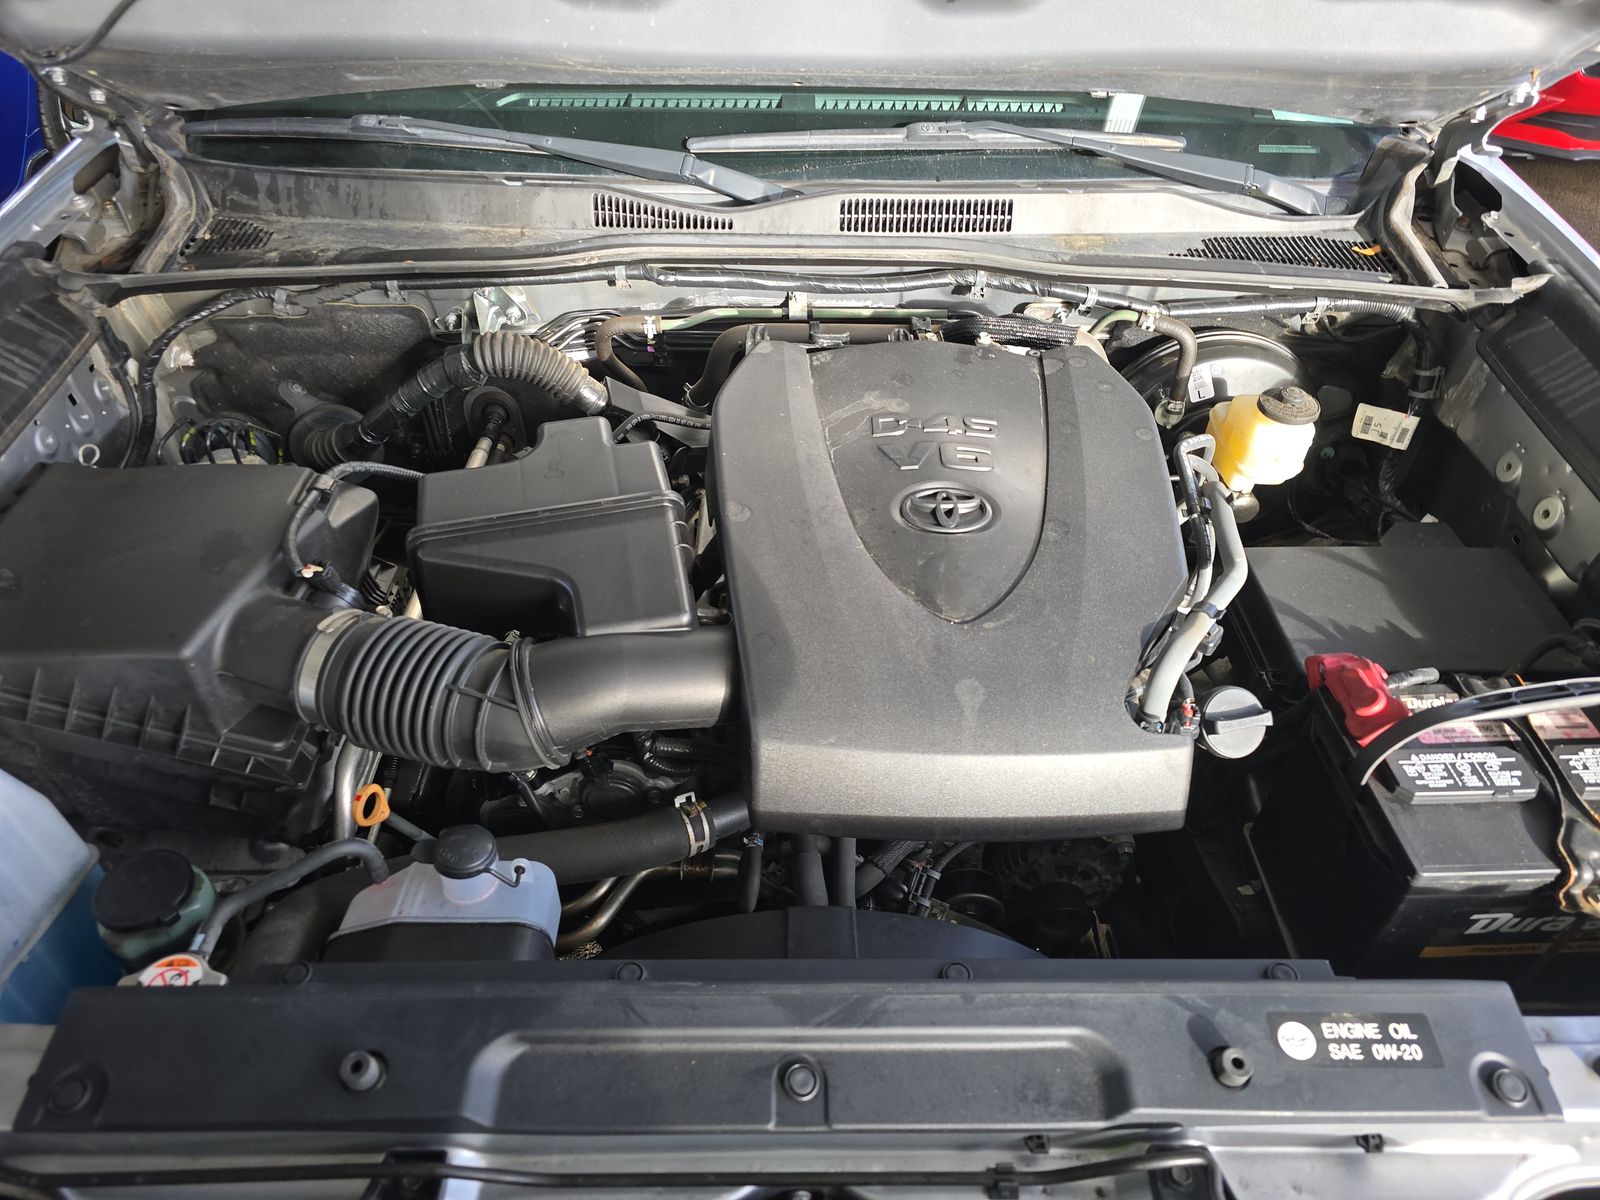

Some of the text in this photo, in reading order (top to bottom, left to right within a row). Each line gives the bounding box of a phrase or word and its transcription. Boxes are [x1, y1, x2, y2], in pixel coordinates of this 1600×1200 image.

[870, 414, 1000, 439] D-4S
[875, 440, 995, 472] V6
[1401, 695, 1459, 710] Dural
[1320, 1022, 1419, 1040] ENGINE OIL
[1327, 1043, 1424, 1062] SAE 0W-20
